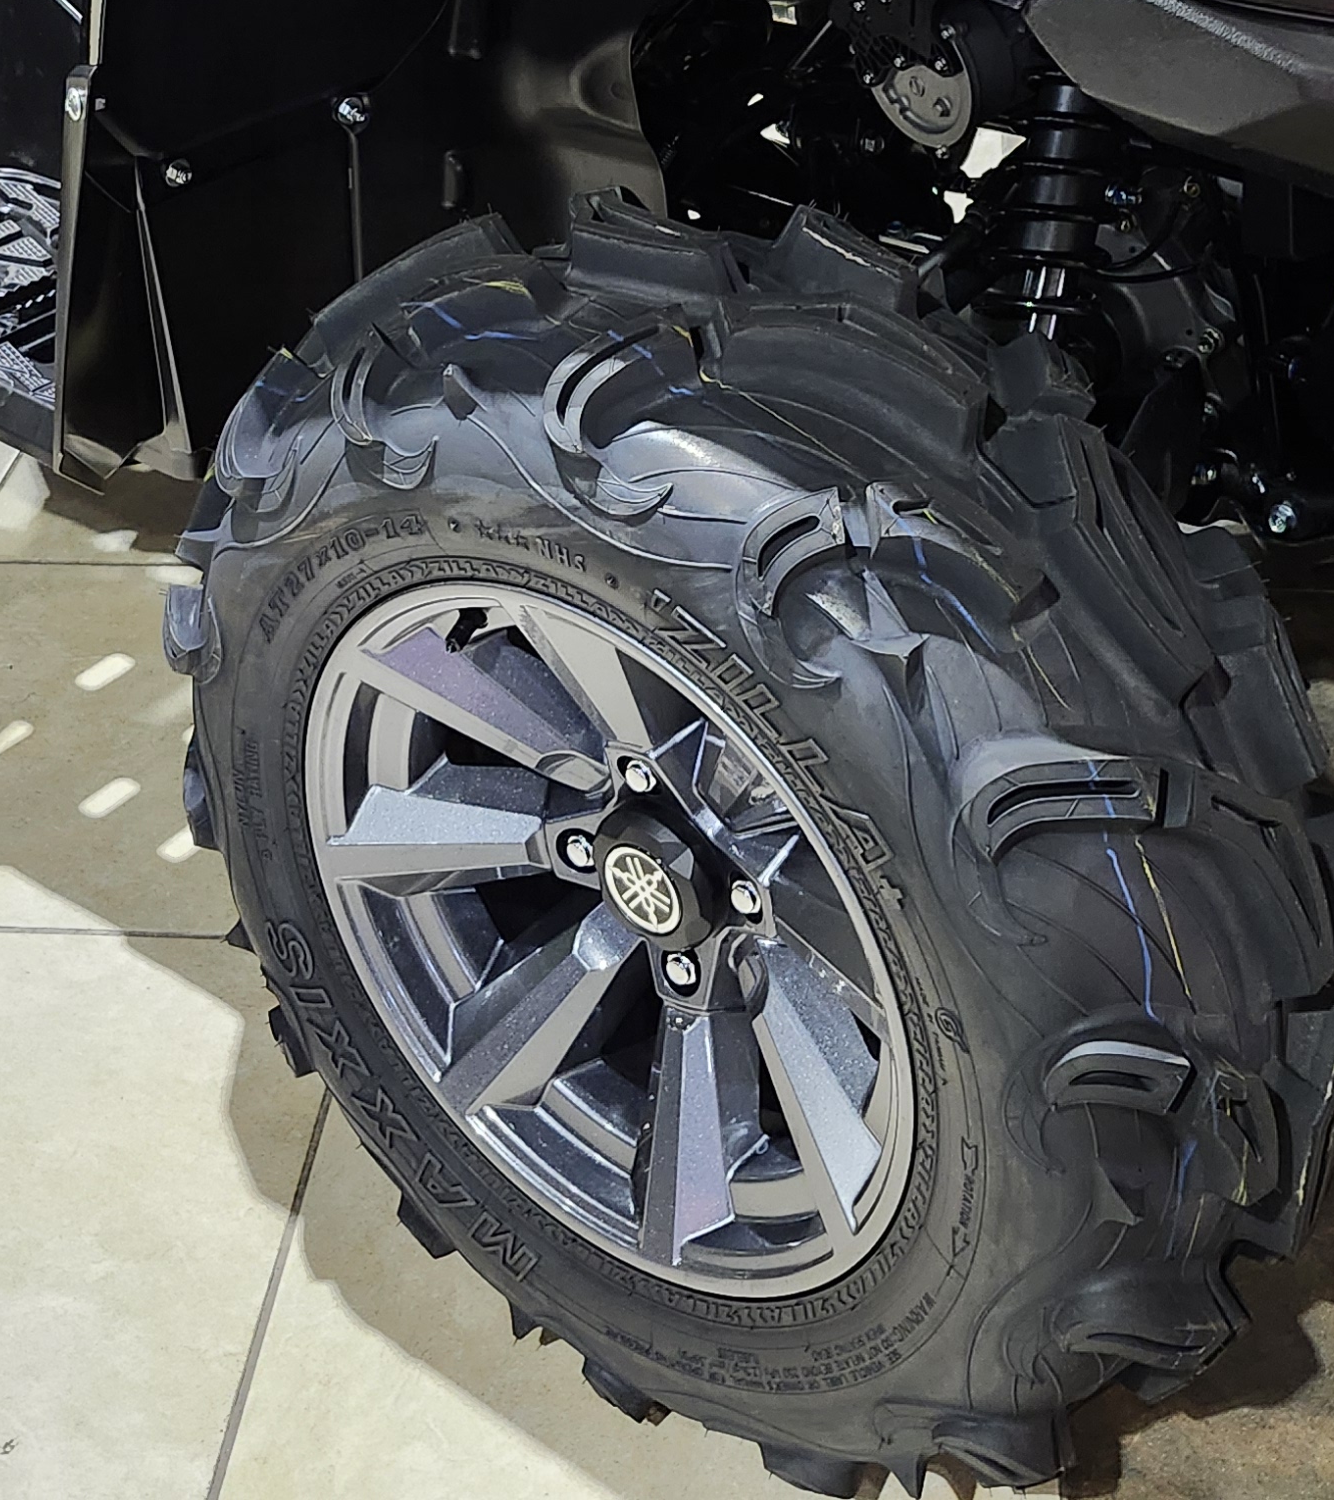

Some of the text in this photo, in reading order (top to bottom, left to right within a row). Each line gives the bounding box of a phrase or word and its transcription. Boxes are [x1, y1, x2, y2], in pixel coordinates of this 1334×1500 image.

[532, 536, 588, 574] NHS
[266, 920, 539, 1285] MAXXIS
[958, 1174, 976, 1227] ROTATION
